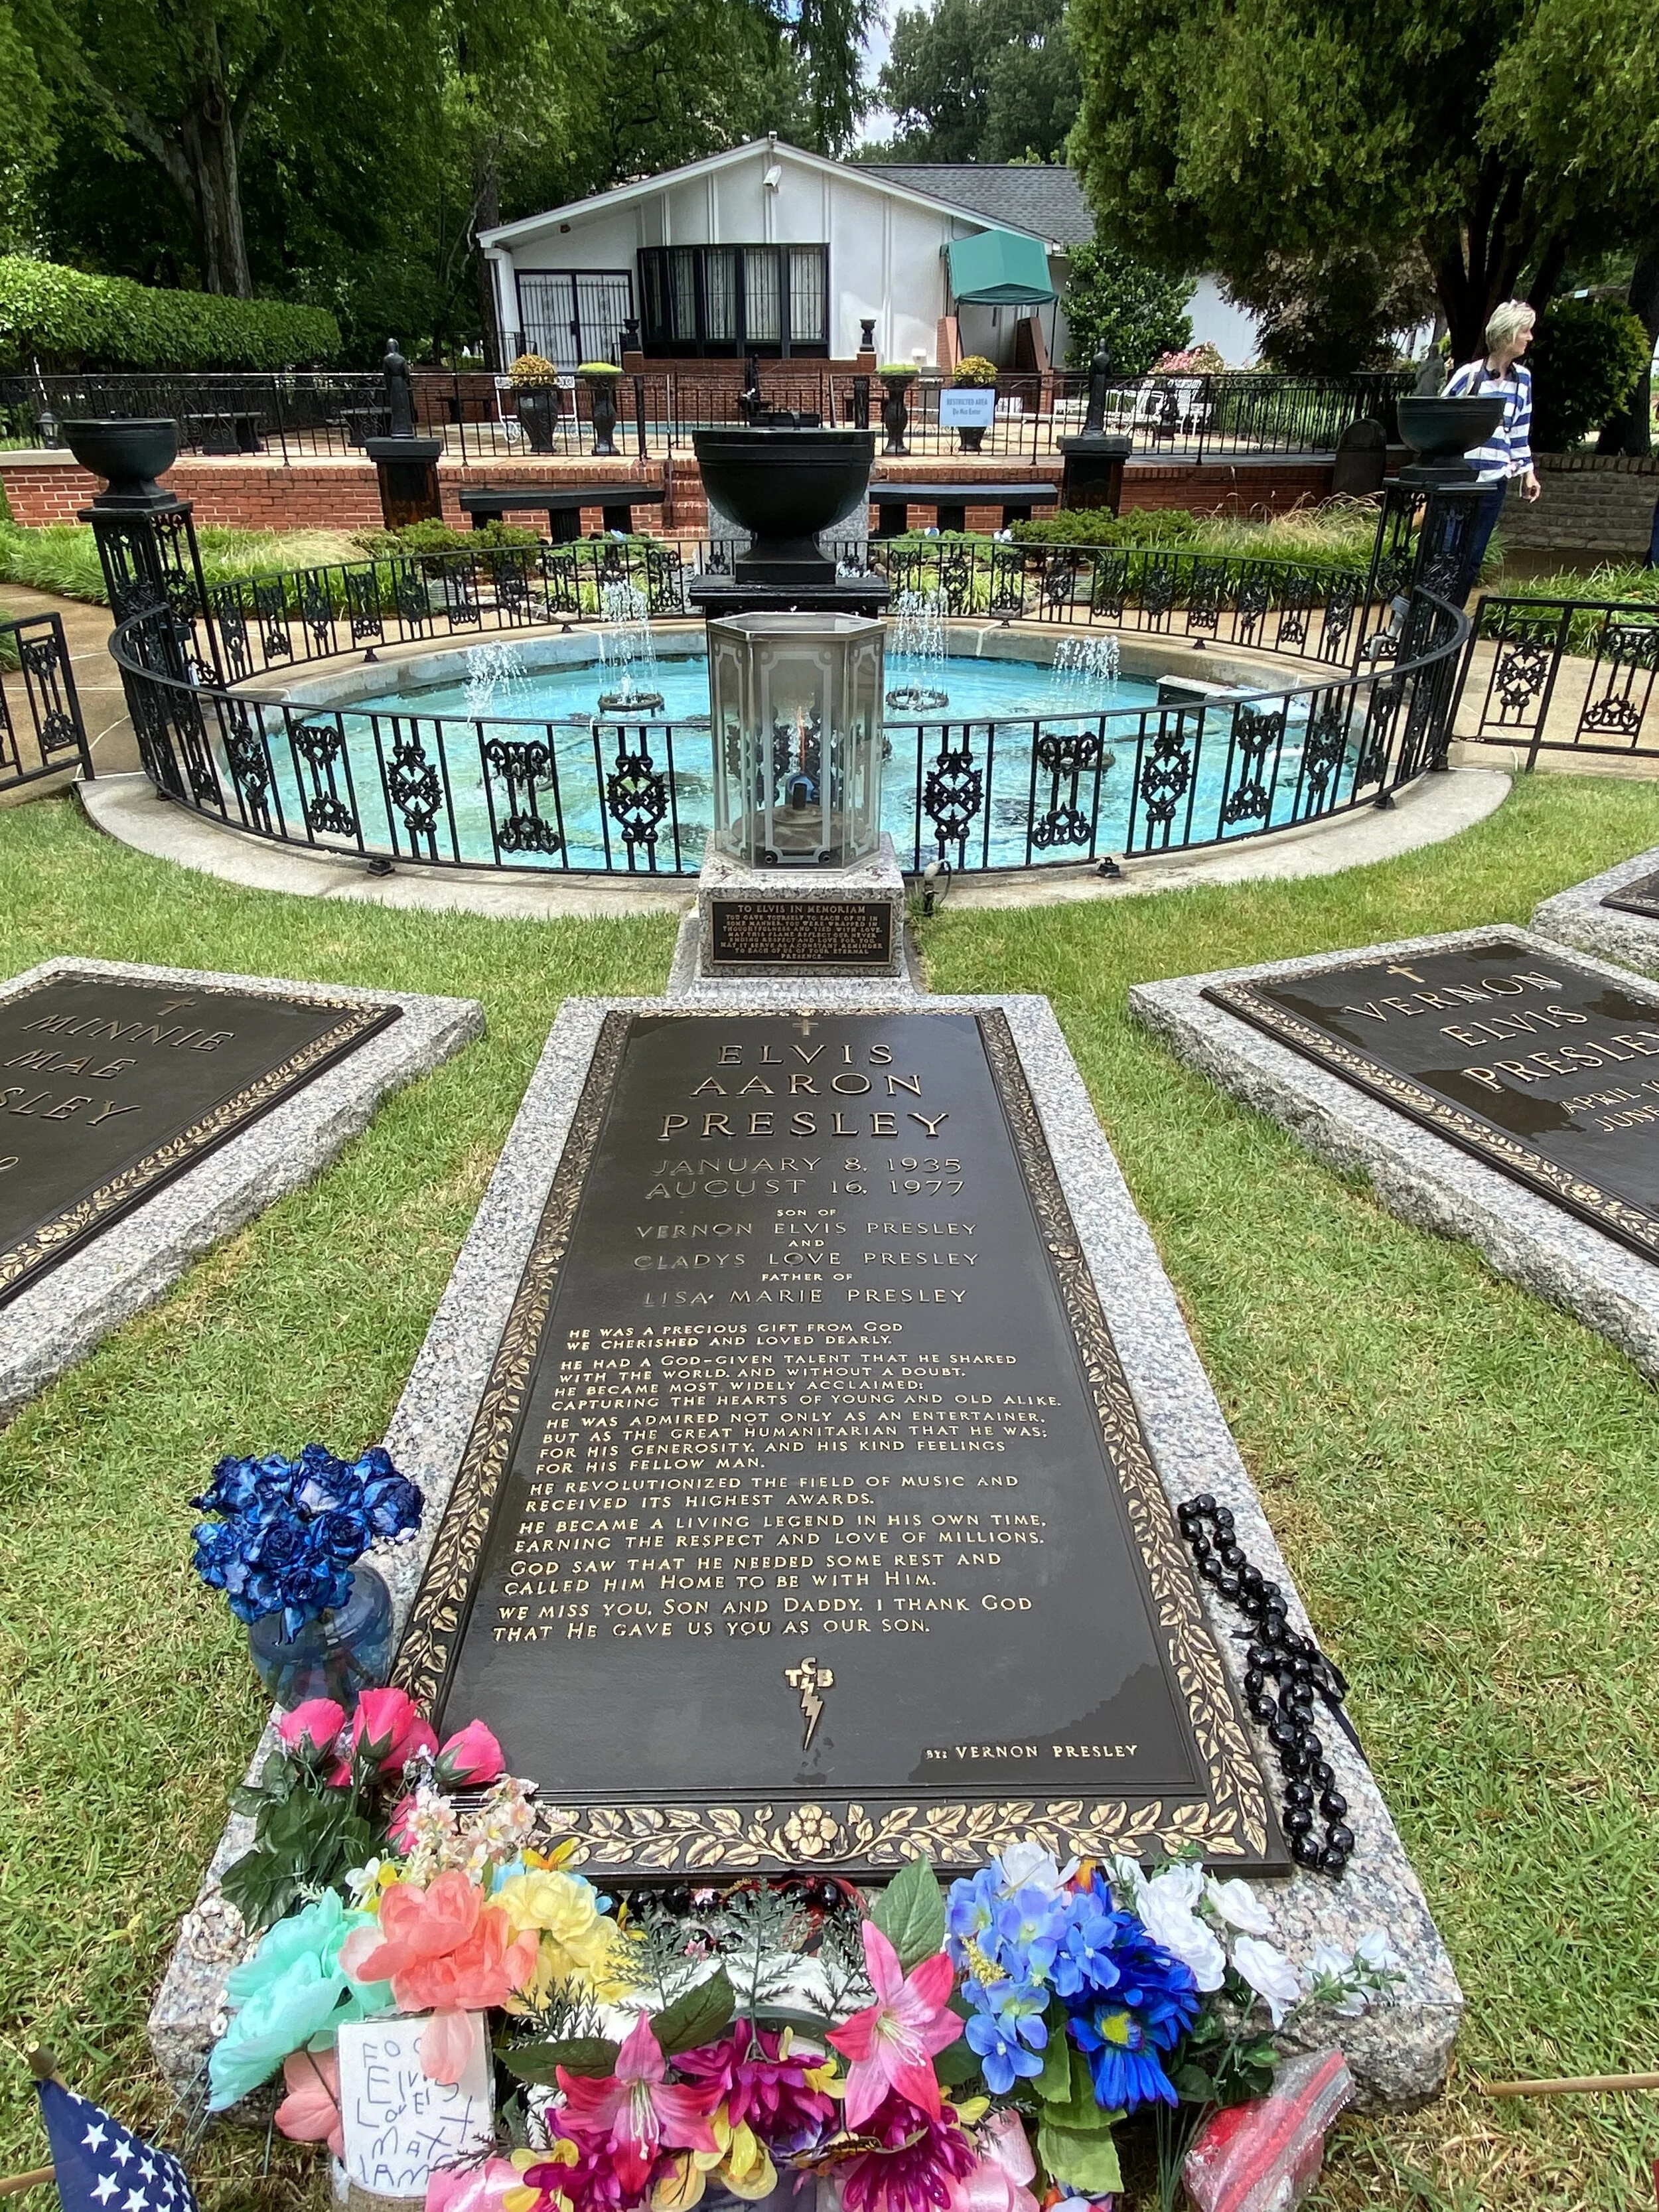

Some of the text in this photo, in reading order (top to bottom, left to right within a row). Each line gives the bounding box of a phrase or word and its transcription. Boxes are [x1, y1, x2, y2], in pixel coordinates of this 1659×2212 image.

[808, 905, 865, 914] MEMORIAM
[1341, 970, 1563, 1023] VERNON
[19, 1013, 235, 1052] MINNIE
[1439, 1003, 1588, 1048] ELVIS
[4, 1049, 137, 1079] MAE
[717, 1044, 893, 1065] ELVIS
[689, 1074, 922, 1097] AARON
[1560, 1088, 1641, 1115] APRIL
[658, 1112, 949, 1139] PRESLEY
[652, 1157, 822, 1175] JANUARY
[887, 1157, 961, 1173] 1935
[644, 1179, 807, 1198] AUGUST
[891, 1179, 964, 1195] 1977
[818, 1209, 836, 1217] OF
[636, 1221, 976, 1240] VERNON ELVIS PRESLEY
[788, 1239, 824, 1248] AND
[769, 1252, 841, 1268] LOVE
[864, 1252, 978, 1265] PRESLEY
[761, 1273, 853, 1282] FATHER OF
[642, 1288, 966, 1308] LISA MARIE PRESLEY
[569, 1329, 591, 1341] HE
[599, 1327, 634, 1337] WAS
[642, 1327, 654, 1337] A
[662, 1324, 748, 1335] PRECIOUS
[757, 1323, 798, 1333] GIFT
[808, 1323, 853, 1333] FROM
[601, 1337, 699, 1350] CHERISHED
[709, 1336, 745, 1347] AND
[756, 1335, 814, 1345] LOVED
[825, 1335, 892, 1345] DEARLY.
[560, 1354, 1017, 1371] HE HAD A GOD-GIVEN TALENT THAT HE SHARED
[559, 1372, 607, 1384] WITH
[618, 1370, 652, 1382] THE
[737, 1368, 776, 1378] AND
[786, 1366, 873, 1378] WITHOUT
[881, 1367, 894, 1376] A
[553, 1380, 923, 1398] HE BECAME MOST WIDELY ACCLAIMED:
[551, 1394, 1062, 1412] CAPTURING THE HEARTS OF YOUNG AND OLD ALIKE.
[545, 1418, 570, 1430] HE
[580, 1416, 618, 1428] WAS
[629, 1413, 719, 1427] ADMIRED
[730, 1412, 769, 1427] NOT
[780, 1412, 832, 1424] ONLY
[844, 1411, 866, 1422] AS
[877, 1411, 901, 1422] AN
[542, 1432, 580, 1445] BUT
[589, 1430, 611, 1442] AS
[622, 1429, 658, 1441] THE
[670, 1428, 733, 1440] GREAT
[745, 1426, 897, 1438] HUMANITARIAN
[908, 1426, 960, 1436] THAT
[970, 1426, 994, 1436] HE
[540, 1447, 577, 1459] FOR
[587, 1445, 618, 1458] HIS
[764, 1441, 804, 1453] AND
[817, 1441, 847, 1453] HIS
[859, 1440, 904, 1451] KIND
[917, 1441, 1005, 1452] FEELINGS
[536, 1457, 765, 1475] FOR HIS FELLOW MAN.
[525, 1493, 875, 1513] RECEIVED ITS HIGHEST AWARDS.
[504, 1579, 590, 1595] CALLED
[603, 1578, 645, 1593] HIM
[736, 1576, 764, 1589] TO
[776, 1575, 799, 1589] BE
[812, 1573, 869, 1587] WITH
[885, 1571, 936, 1585] HIM.
[955, 1745, 1038, 1760] VERNON
[1052, 1745, 1138, 1758] PRESLEY
